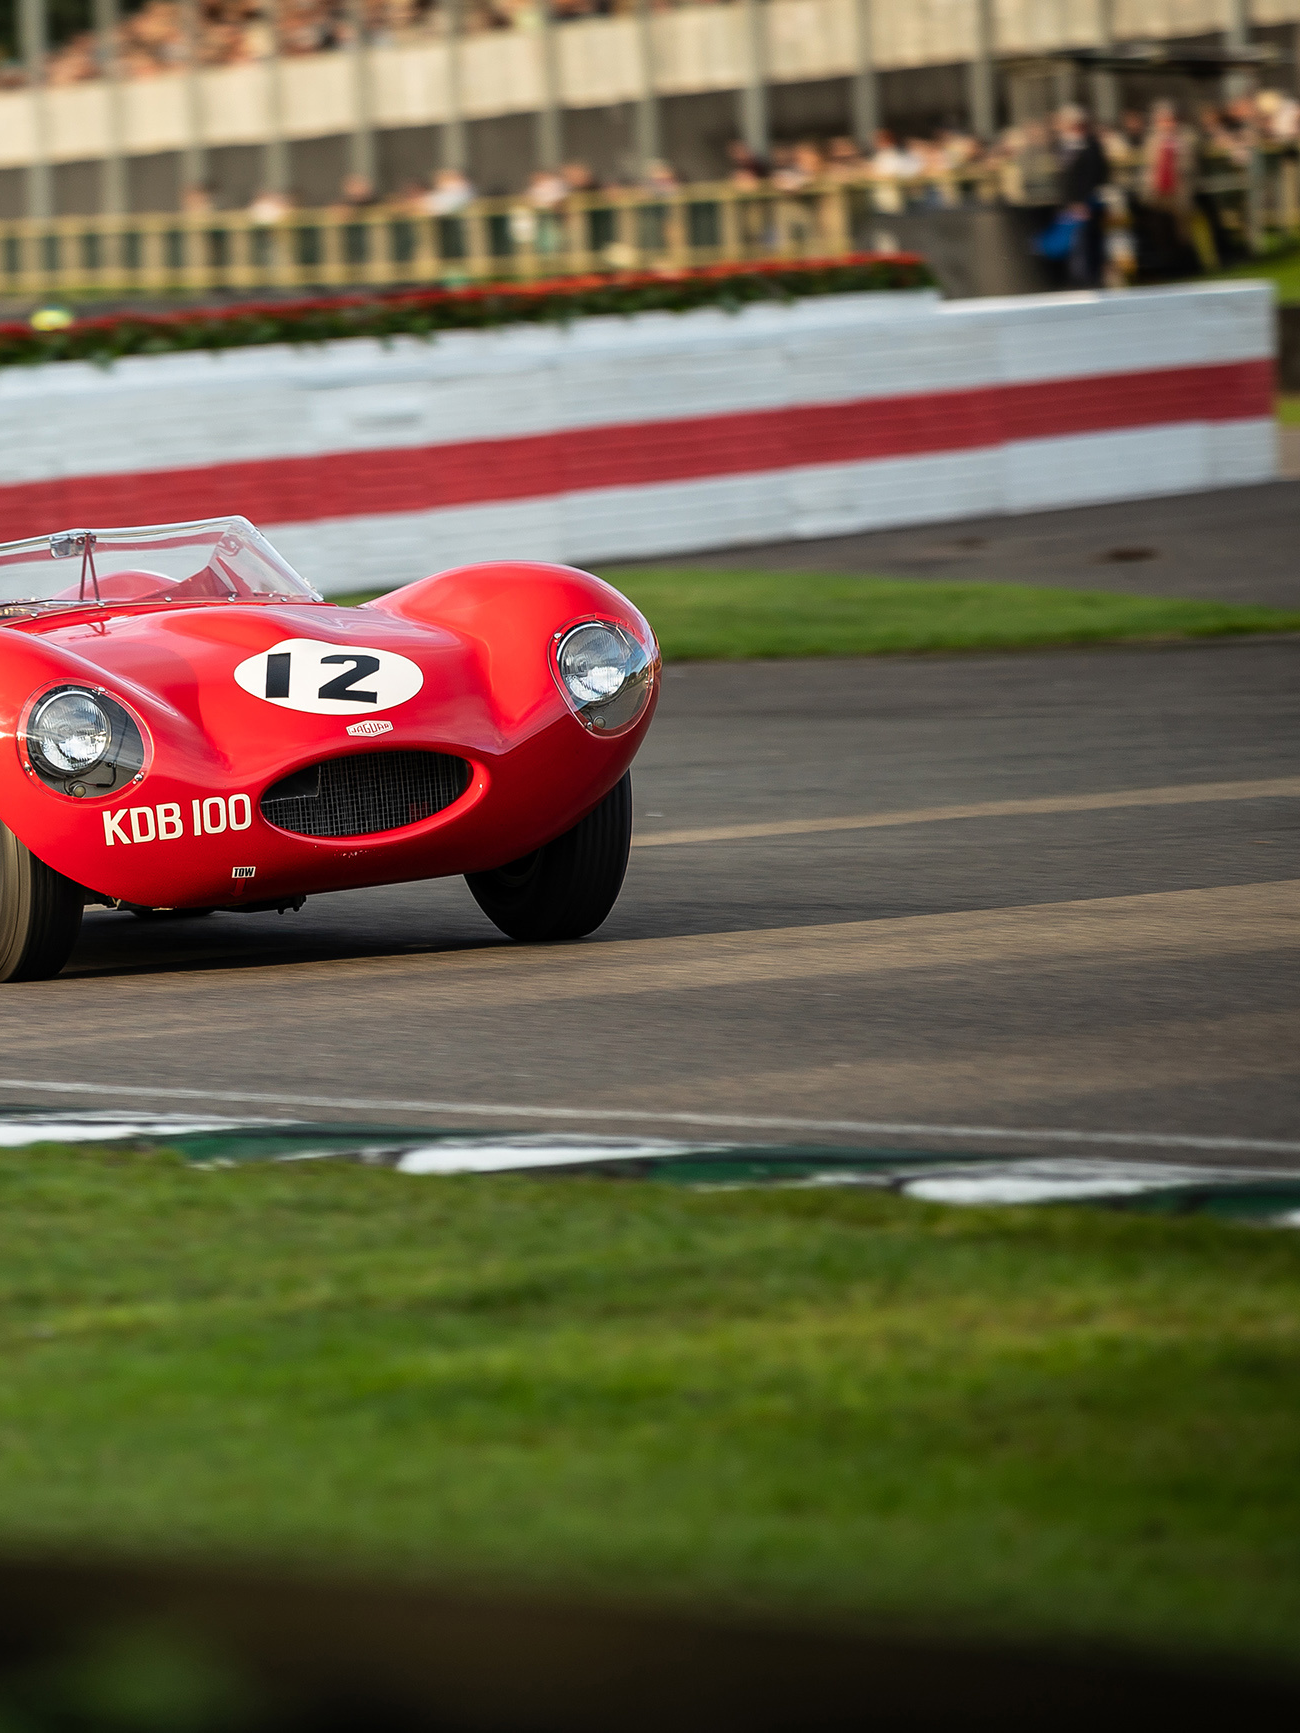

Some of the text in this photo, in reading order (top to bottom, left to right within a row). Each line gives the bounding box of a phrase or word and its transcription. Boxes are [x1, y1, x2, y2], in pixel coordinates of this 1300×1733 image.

[265, 652, 380, 704] 12
[351, 723, 390, 734] JAGUAR
[102, 793, 252, 846] KDB 100
[233, 867, 255, 878] TOW
